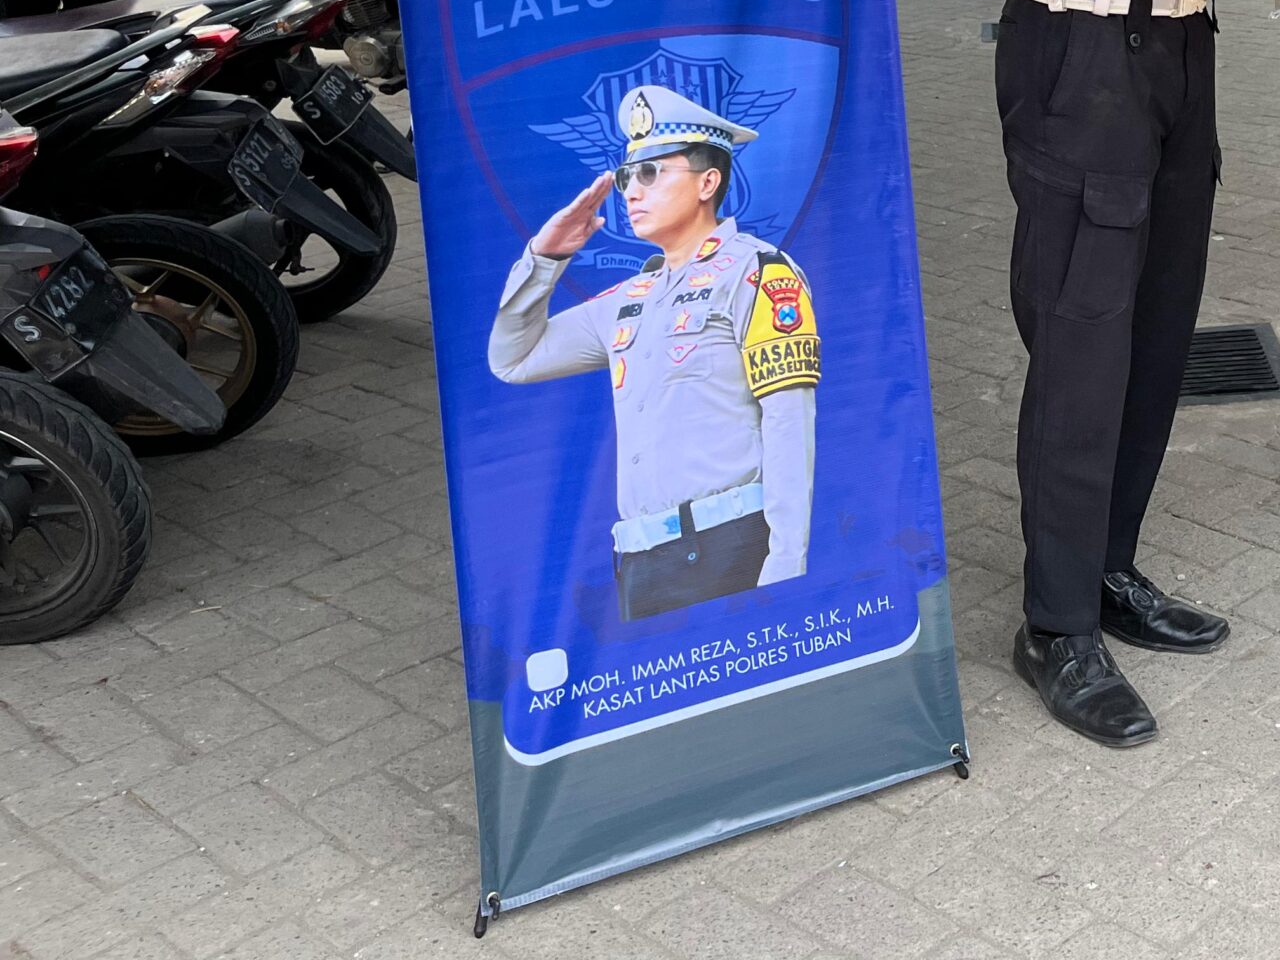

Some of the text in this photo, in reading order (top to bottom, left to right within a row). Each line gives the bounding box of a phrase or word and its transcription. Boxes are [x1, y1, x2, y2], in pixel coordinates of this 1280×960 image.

[303, 101, 321, 119] S
[234, 167, 251, 186] S
[672, 288, 713, 307] POLRI
[14, 315, 40, 342] S
[529, 595, 895, 713] AKP MOH. IMAM REZA, S.T.K., S.I.K., M.H.
[583, 628, 851, 718] KASAT LANTAS POLRES TUBAN
